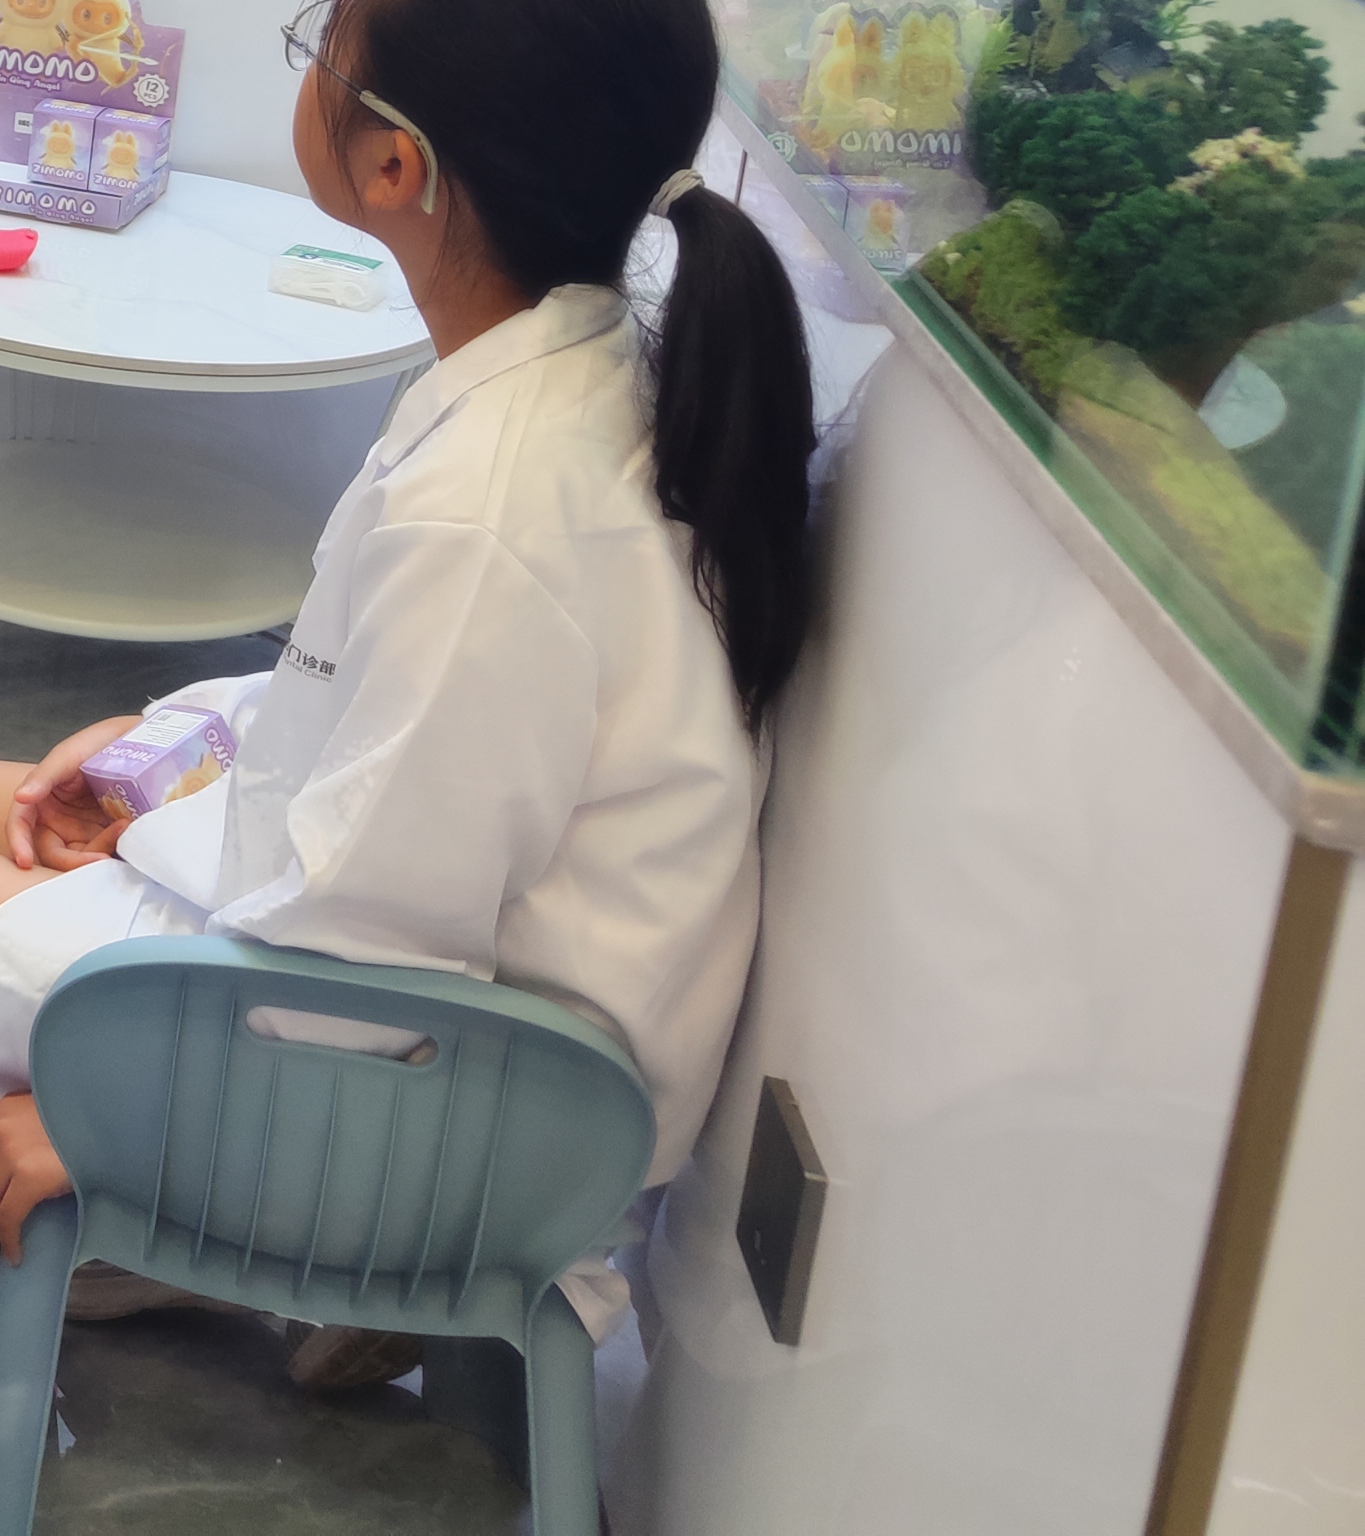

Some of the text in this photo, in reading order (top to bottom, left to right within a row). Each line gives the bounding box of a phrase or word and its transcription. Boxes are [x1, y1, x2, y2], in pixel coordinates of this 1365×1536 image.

[9, 75, 31, 88] Qing
[33, 79, 61, 91] Angel
[145, 80, 159, 93] 12
[143, 92, 157, 100] PCS
[32, 164, 85, 181] ZIMOMO
[93, 174, 138, 190] ZIMOM
[285, 643, 337, 676] 门诊部
[304, 668, 333, 683] Clinic
[102, 745, 156, 762] ZIMOMO
